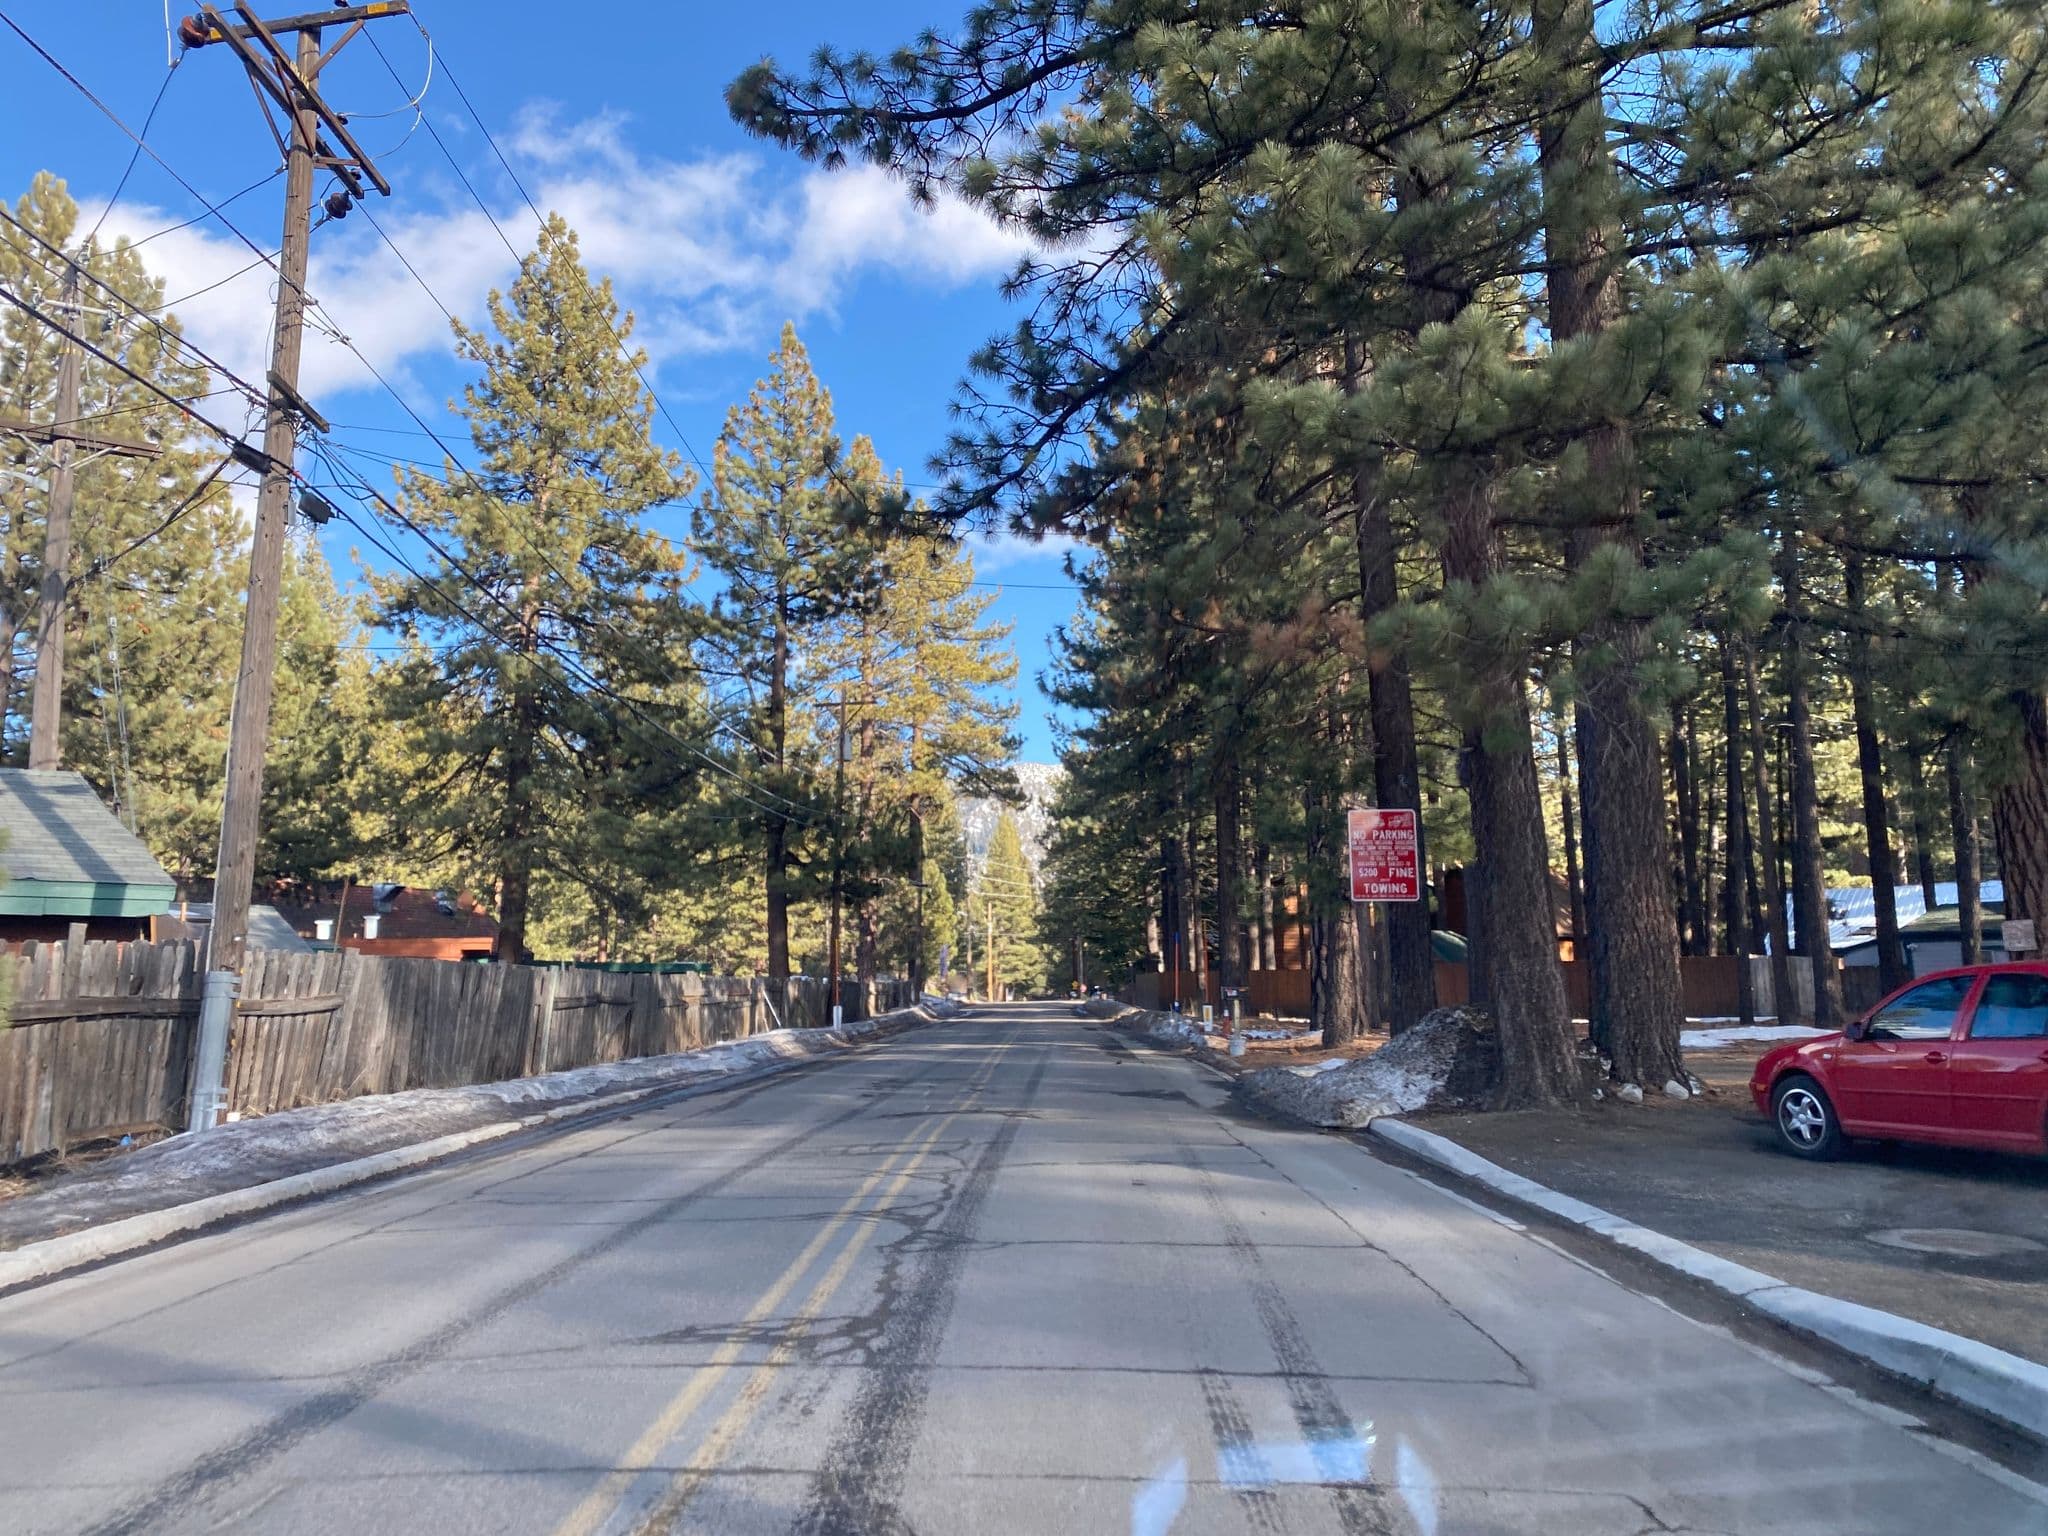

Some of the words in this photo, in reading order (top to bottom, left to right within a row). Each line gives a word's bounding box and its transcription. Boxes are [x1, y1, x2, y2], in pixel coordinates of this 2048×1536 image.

[1353, 830, 1366, 840] NO
[1372, 829, 1414, 840] PARKING
[1388, 867, 1415, 878] FINE
[1363, 883, 1408, 894] TOWING
